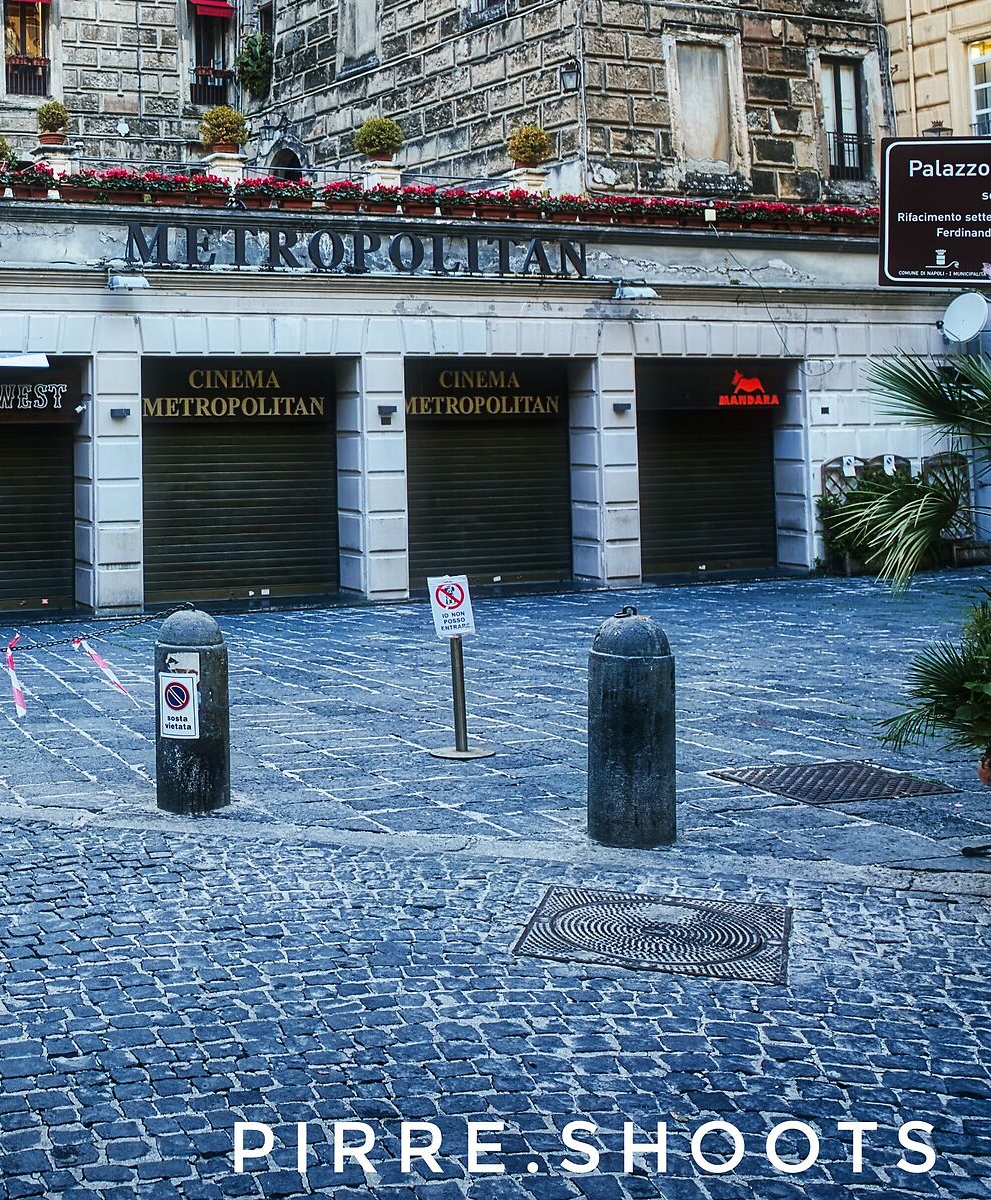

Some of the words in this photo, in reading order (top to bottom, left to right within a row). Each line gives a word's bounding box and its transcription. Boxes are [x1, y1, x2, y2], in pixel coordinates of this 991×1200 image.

[909, 159, 990, 177] Palazzo
[897, 212, 962, 222] Rifacimento
[936, 227, 991, 237] Ferdinand
[125, 222, 589, 278] METROPOLITAN
[188, 369, 281, 389] CINEMA
[439, 370, 521, 389] CINEMA
[142, 397, 325, 417] METROPOLITAN
[405, 396, 560, 416] METROPOLITAN
[718, 394, 780, 406] MANDARA
[443, 617, 466, 625] POSSO
[165, 723, 192, 731] vietata
